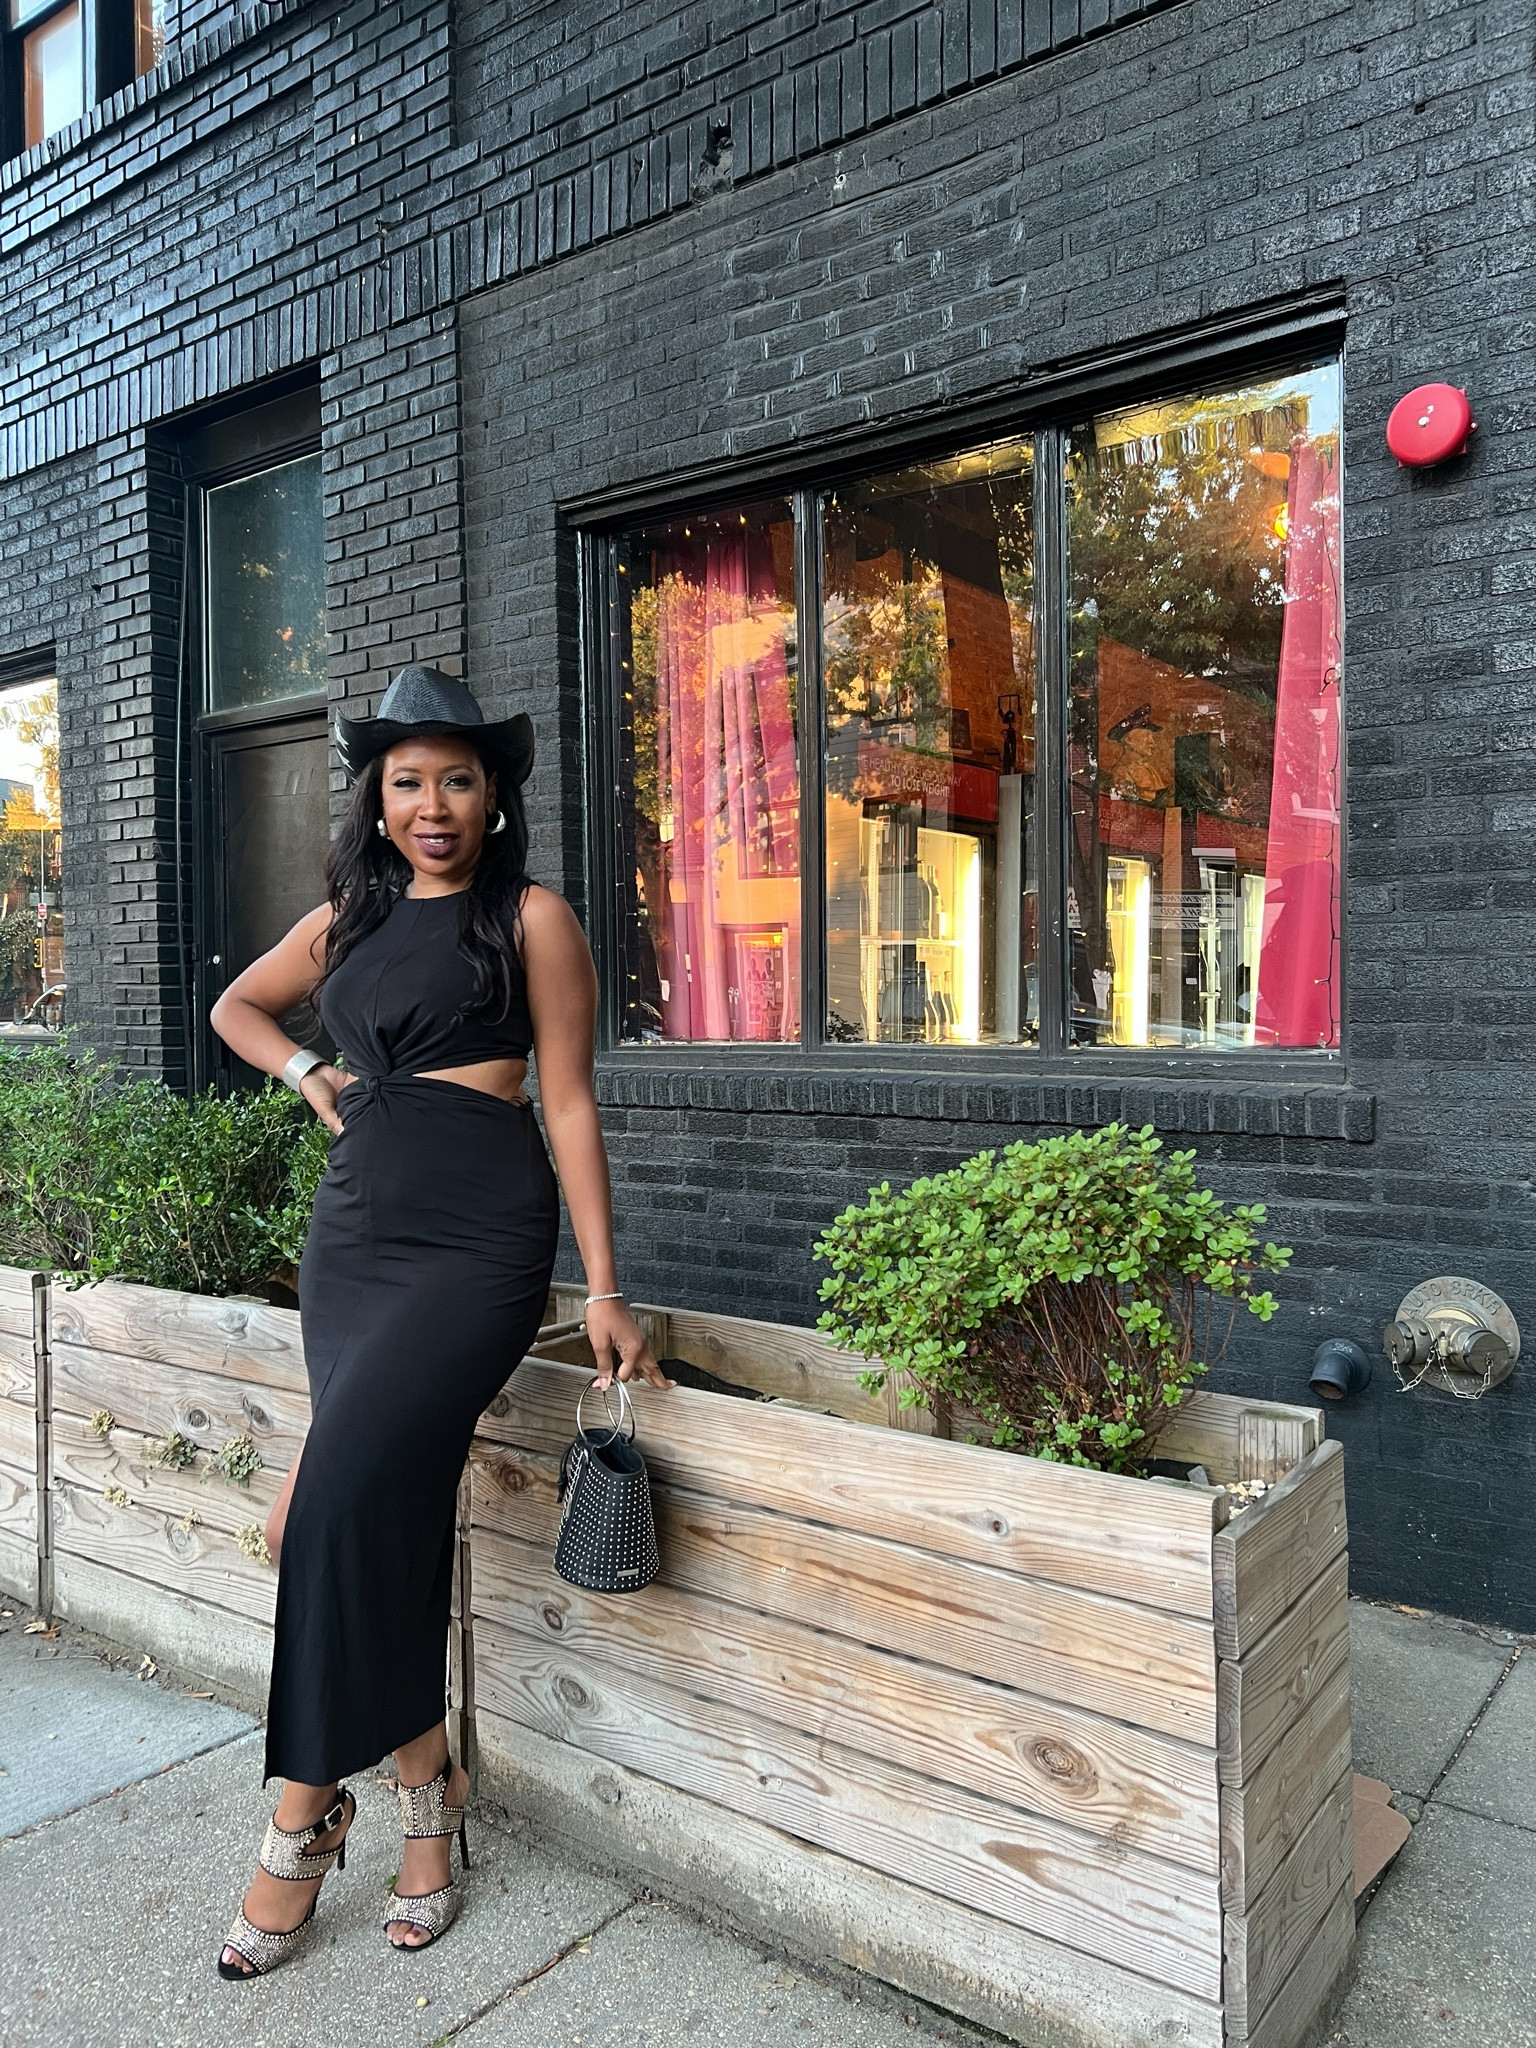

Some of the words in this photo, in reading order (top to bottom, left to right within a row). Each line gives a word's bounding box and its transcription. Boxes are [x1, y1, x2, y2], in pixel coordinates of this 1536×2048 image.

[869, 757, 901, 775] HEALTHY
[947, 774, 962, 788] WAY
[891, 774, 901, 787] TO
[902, 777, 920, 792] LOSE
[922, 782, 950, 798] WEIGHT!
[1401, 1282, 1442, 1319] AUTO
[1450, 1281, 1501, 1316] SPKR
